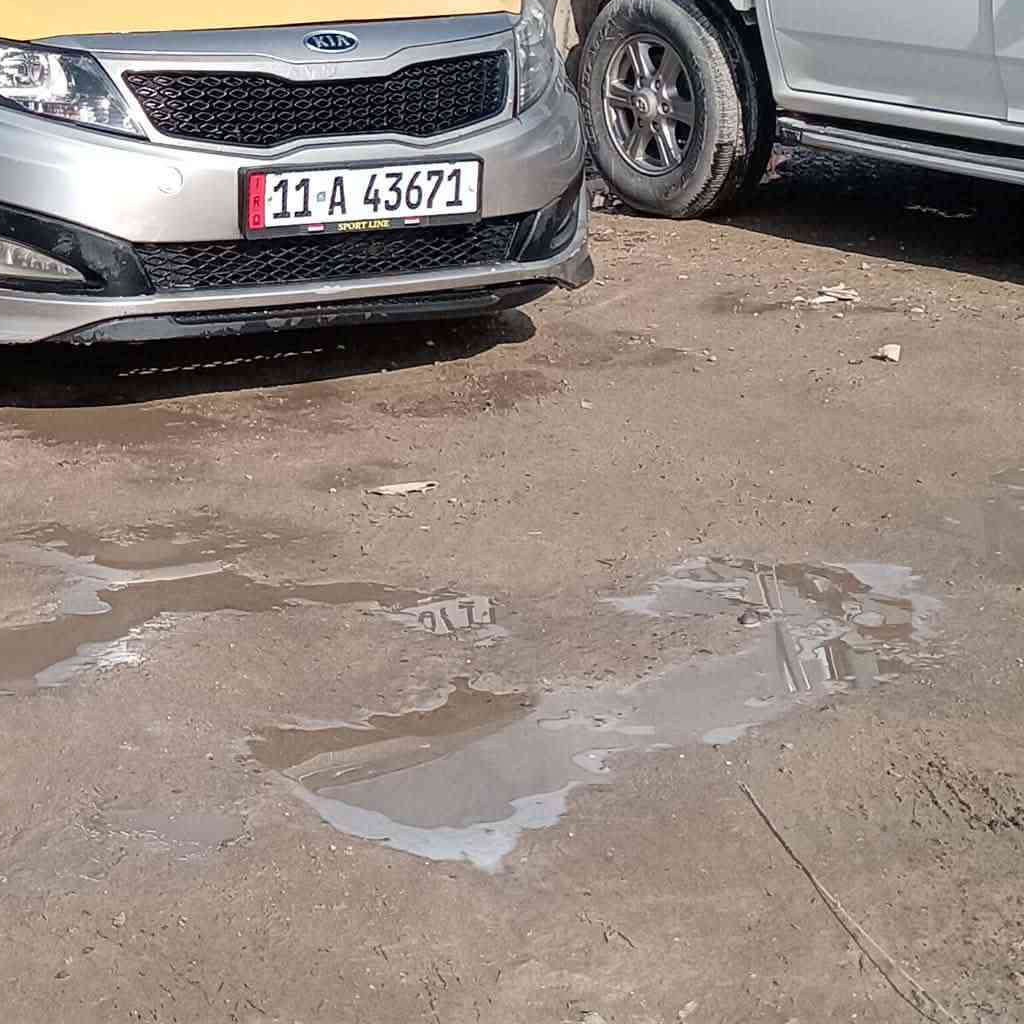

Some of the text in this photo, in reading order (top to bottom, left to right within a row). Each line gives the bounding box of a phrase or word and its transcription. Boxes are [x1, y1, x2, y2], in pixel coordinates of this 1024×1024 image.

[312, 35, 351, 47] KIA
[273, 168, 463, 219] 11 A 43671
[337, 220, 390, 231] SPORT LINE
